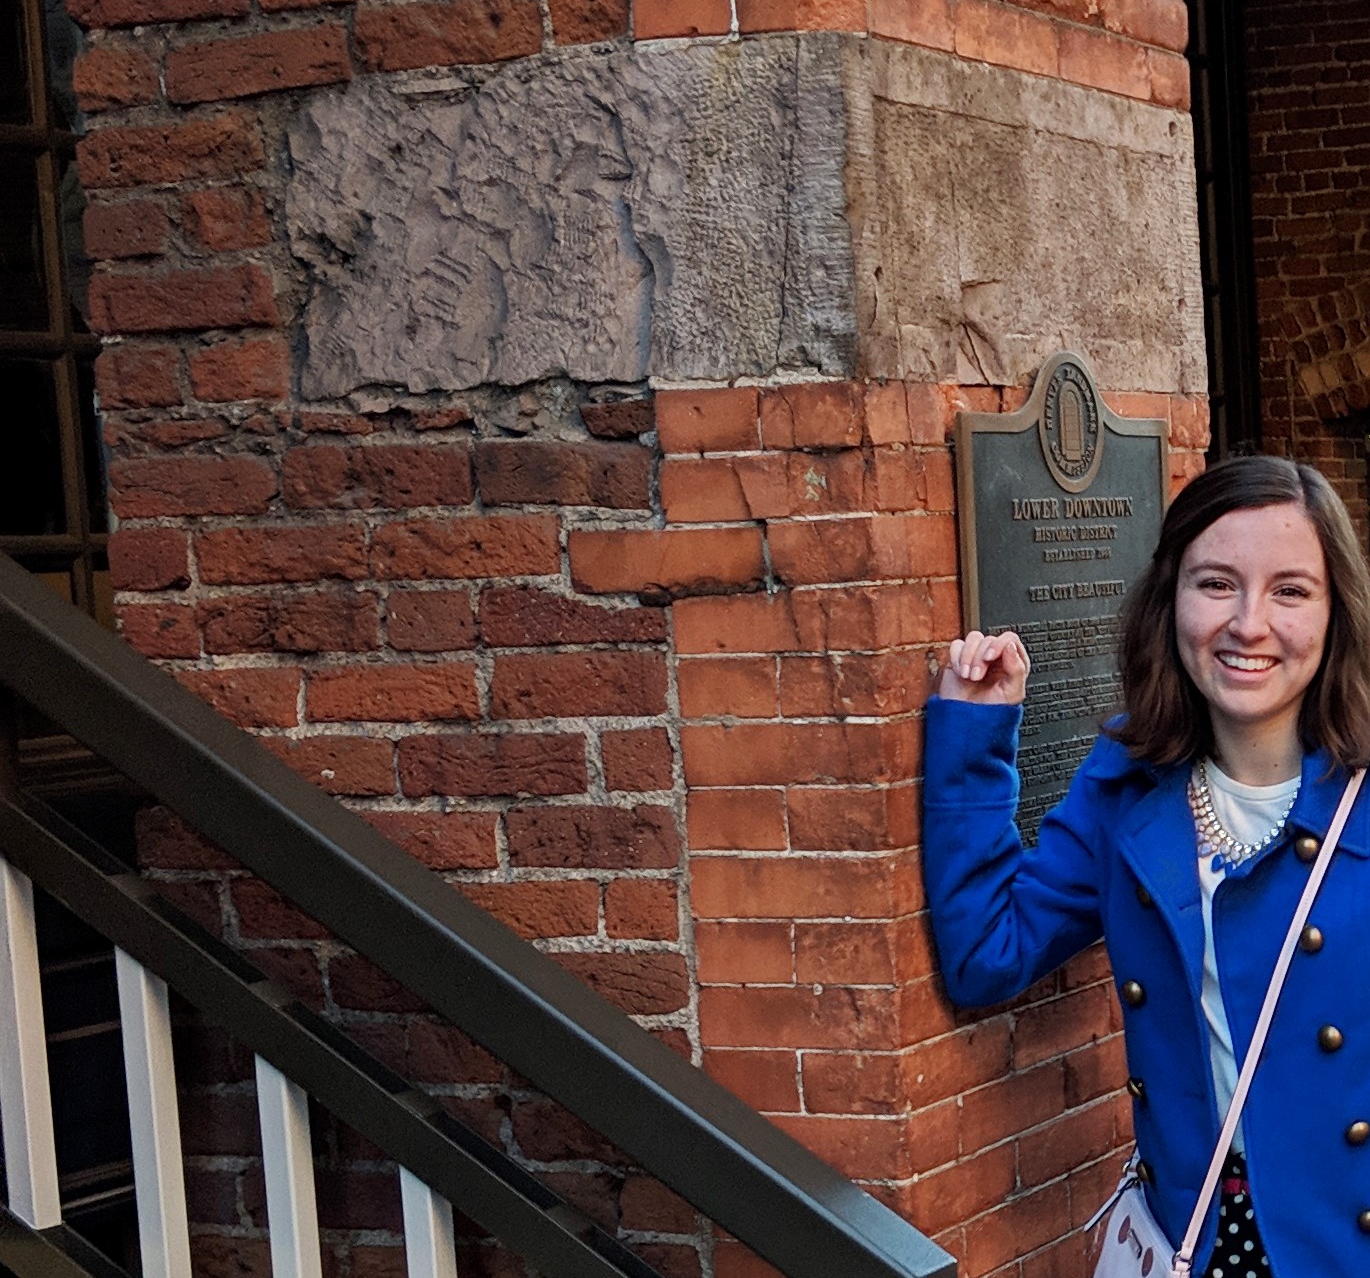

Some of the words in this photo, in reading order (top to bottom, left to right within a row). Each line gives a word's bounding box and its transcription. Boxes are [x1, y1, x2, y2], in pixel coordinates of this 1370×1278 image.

[1012, 498, 1059, 520] LOWER
[1064, 496, 1134, 518] DOWNTOWN
[1034, 525, 1076, 542] HISTORIC
[1079, 524, 1118, 540] DISTRICT
[1029, 585, 1050, 602] THE
[1051, 583, 1075, 600] CITY
